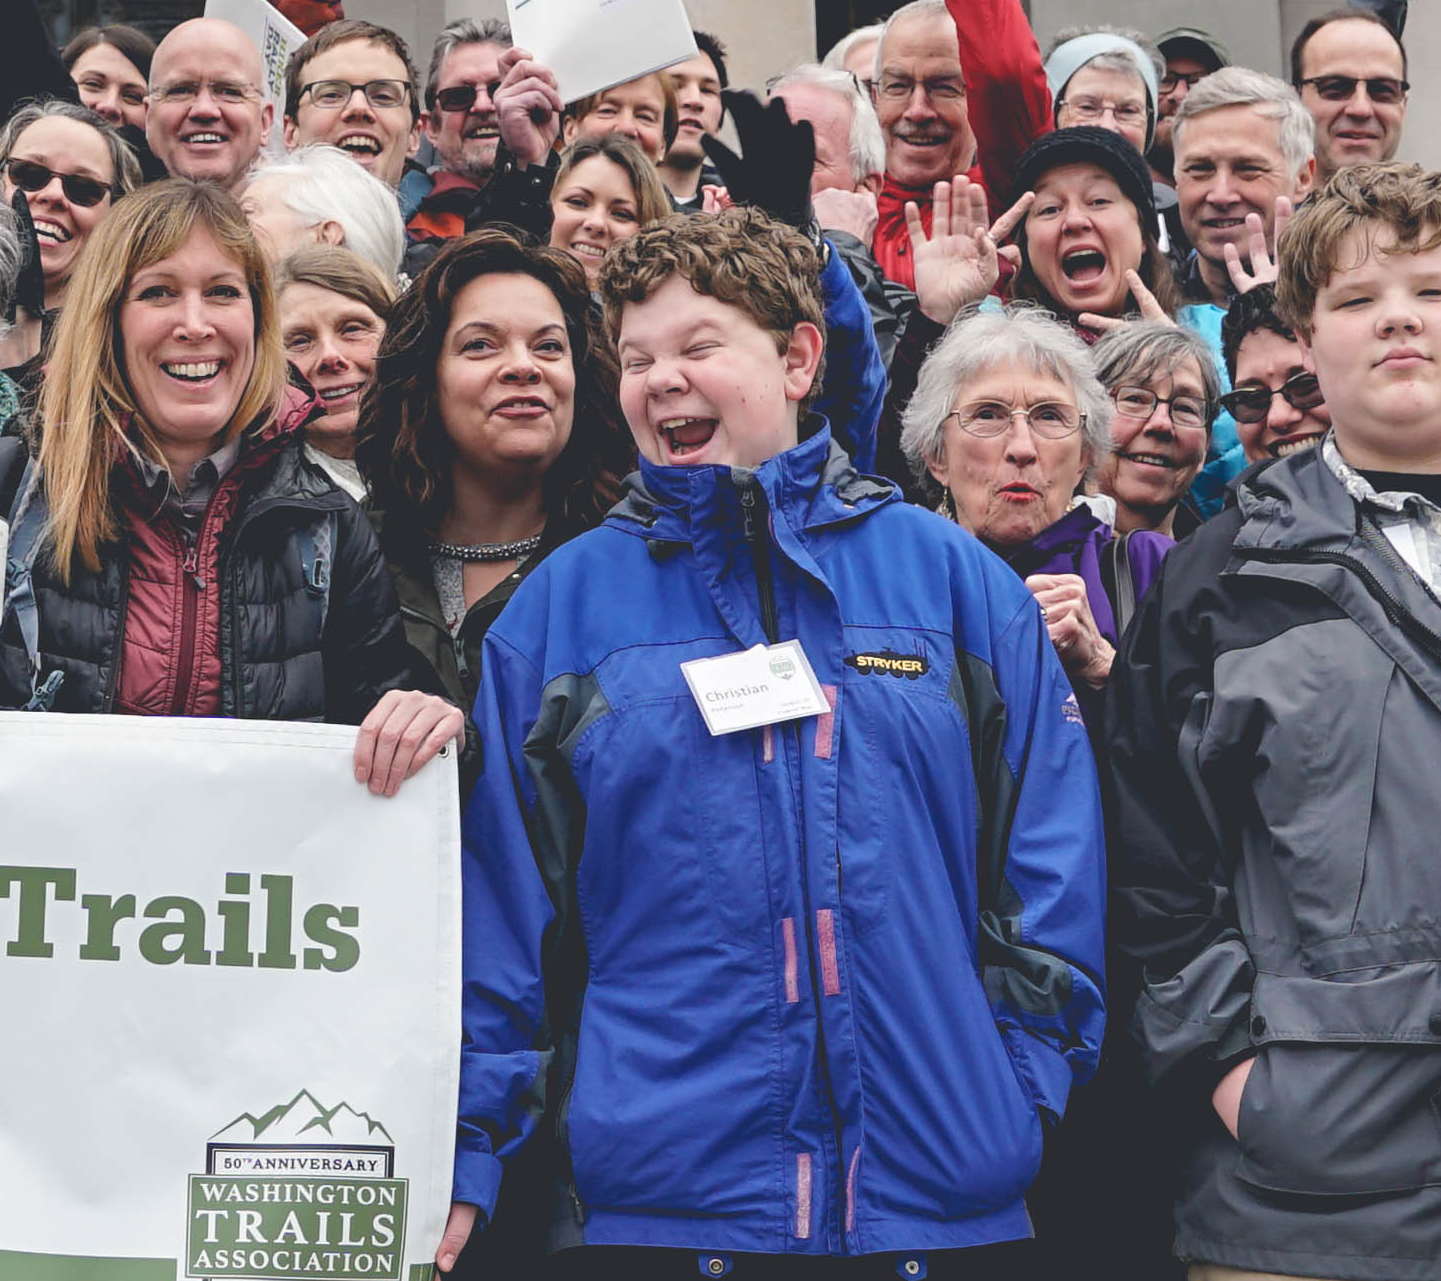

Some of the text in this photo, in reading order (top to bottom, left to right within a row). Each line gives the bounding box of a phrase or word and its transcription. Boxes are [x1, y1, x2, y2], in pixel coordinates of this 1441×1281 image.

[267, 30, 280, 92] RALLY
[856, 655, 923, 672] STRYKER
[706, 683, 769, 703] Christian
[200, 1183, 396, 1206] WASHINGTON
[195, 1209, 395, 1247] TRAILS
[193, 1249, 394, 1272] ASSOCIATION
